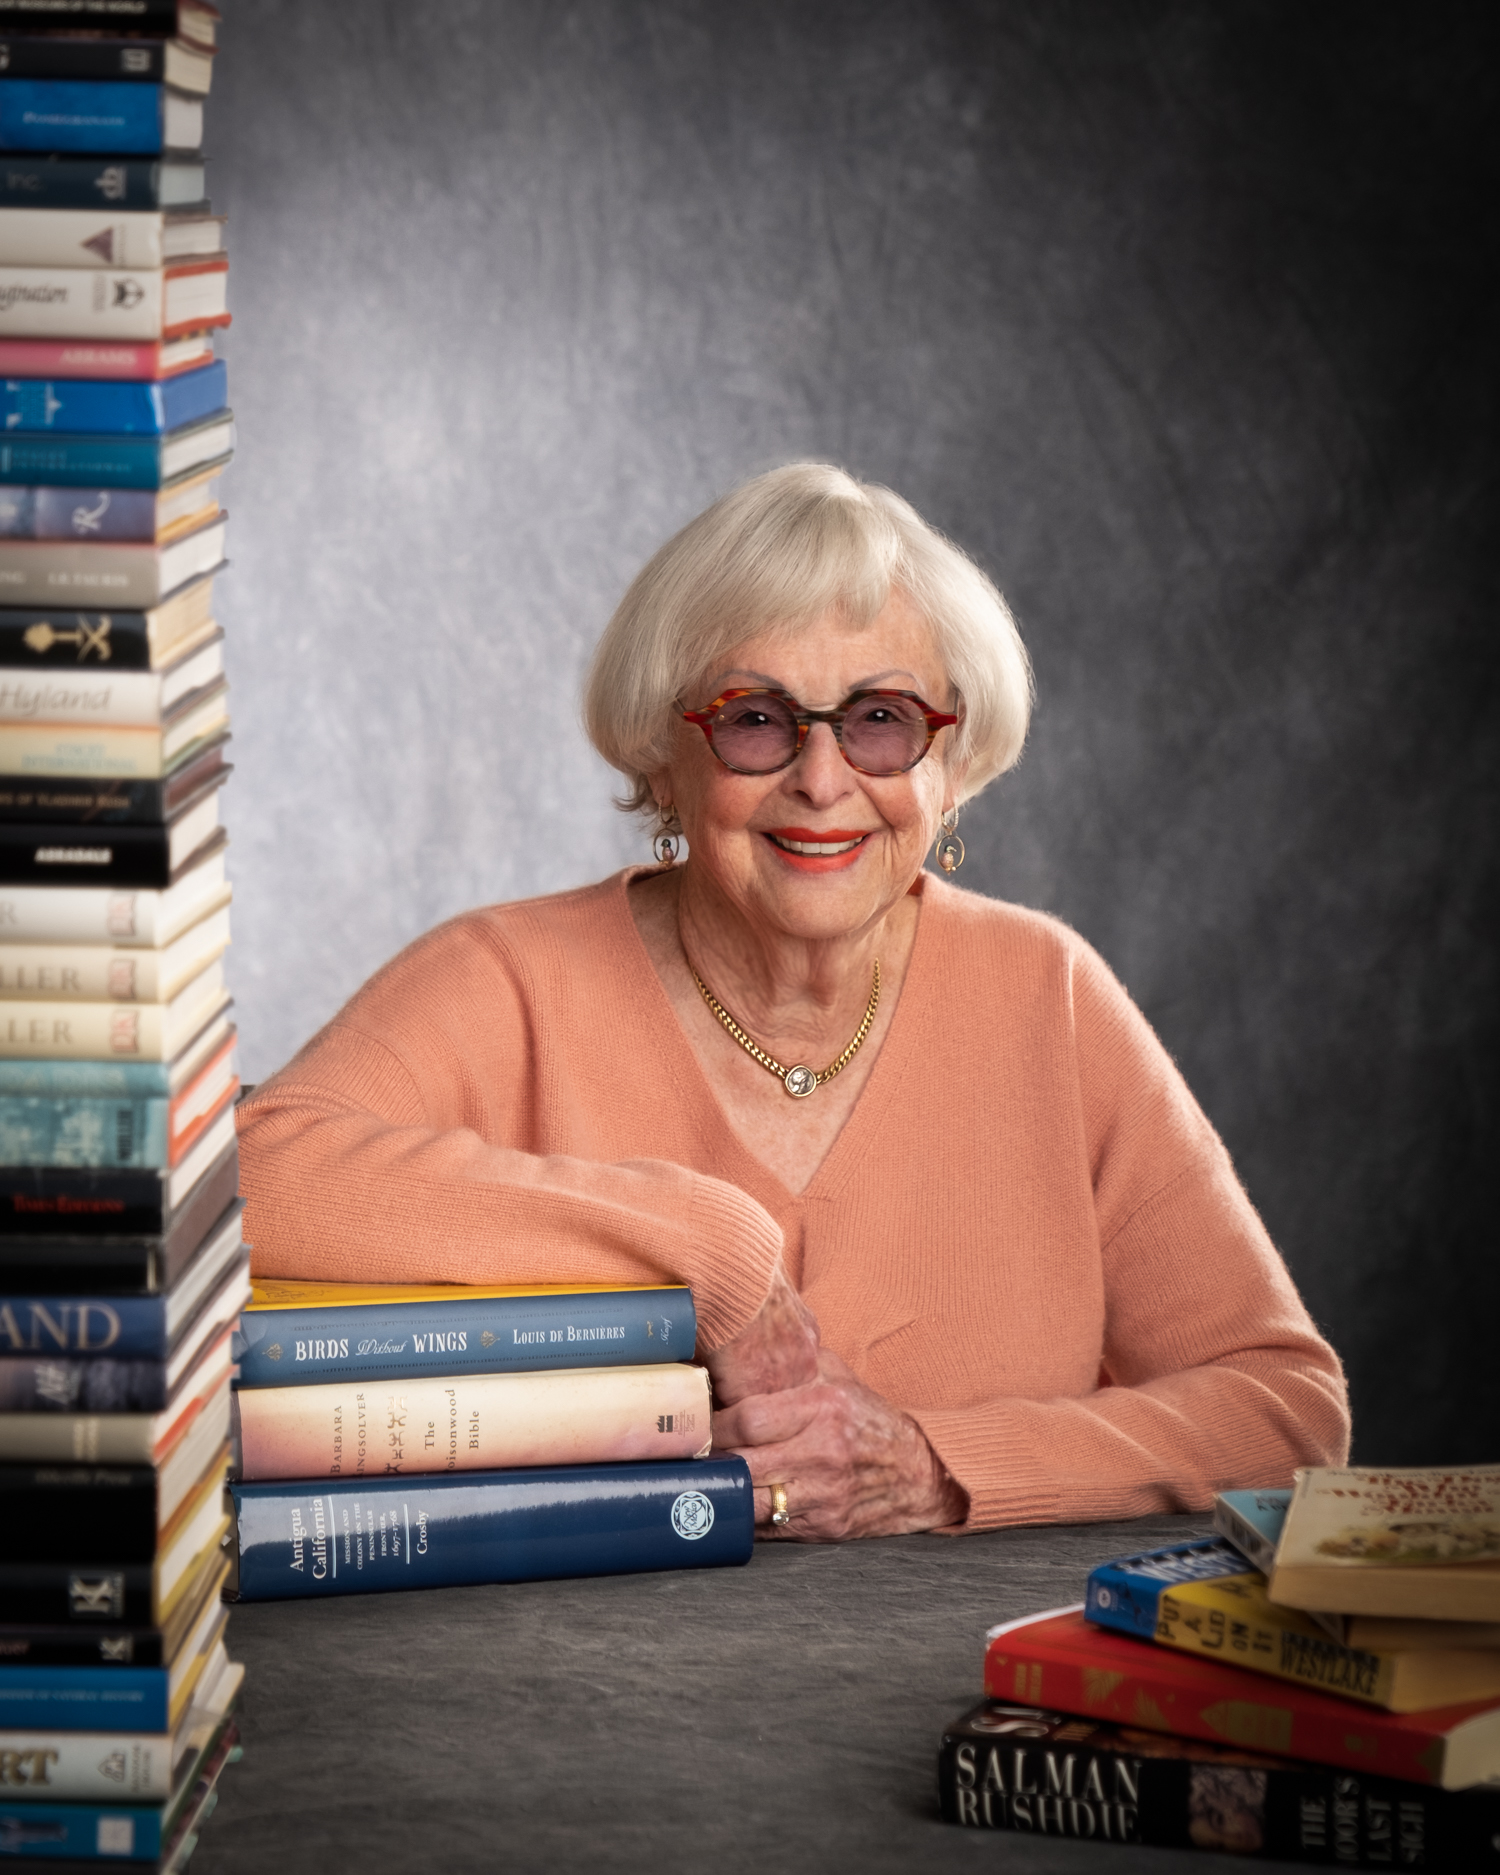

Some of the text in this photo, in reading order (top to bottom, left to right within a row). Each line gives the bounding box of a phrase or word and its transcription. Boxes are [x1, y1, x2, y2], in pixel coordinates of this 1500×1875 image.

[295, 1331, 468, 1361] BIRDS Without WINGS
[513, 1328, 546, 1345] LOUIS
[550, 1330, 564, 1343] DE
[331, 1405, 342, 1474] BARBARA
[354, 1393, 366, 1476] INGSOLVER
[424, 1421, 435, 1450] The
[445, 1389, 456, 1472] oisonwood
[469, 1410, 479, 1450] Bible
[290, 1508, 307, 1572] Antigua
[311, 1498, 327, 1579] California
[355, 1521, 362, 1535] ON
[367, 1510, 375, 1561] PENINSULAR
[390, 1510, 401, 1557] 1697-1768
[416, 1510, 429, 1554] Crosby
[1159, 1593, 1181, 1641] PUT
[1279, 1636, 1382, 1697] WESTLAKE
[956, 1741, 1143, 1802] SALMAN
[956, 1788, 1140, 1844] RUSHDIE
[1301, 1796, 1328, 1850] THE
[1365, 1795, 1393, 1862] LAST
